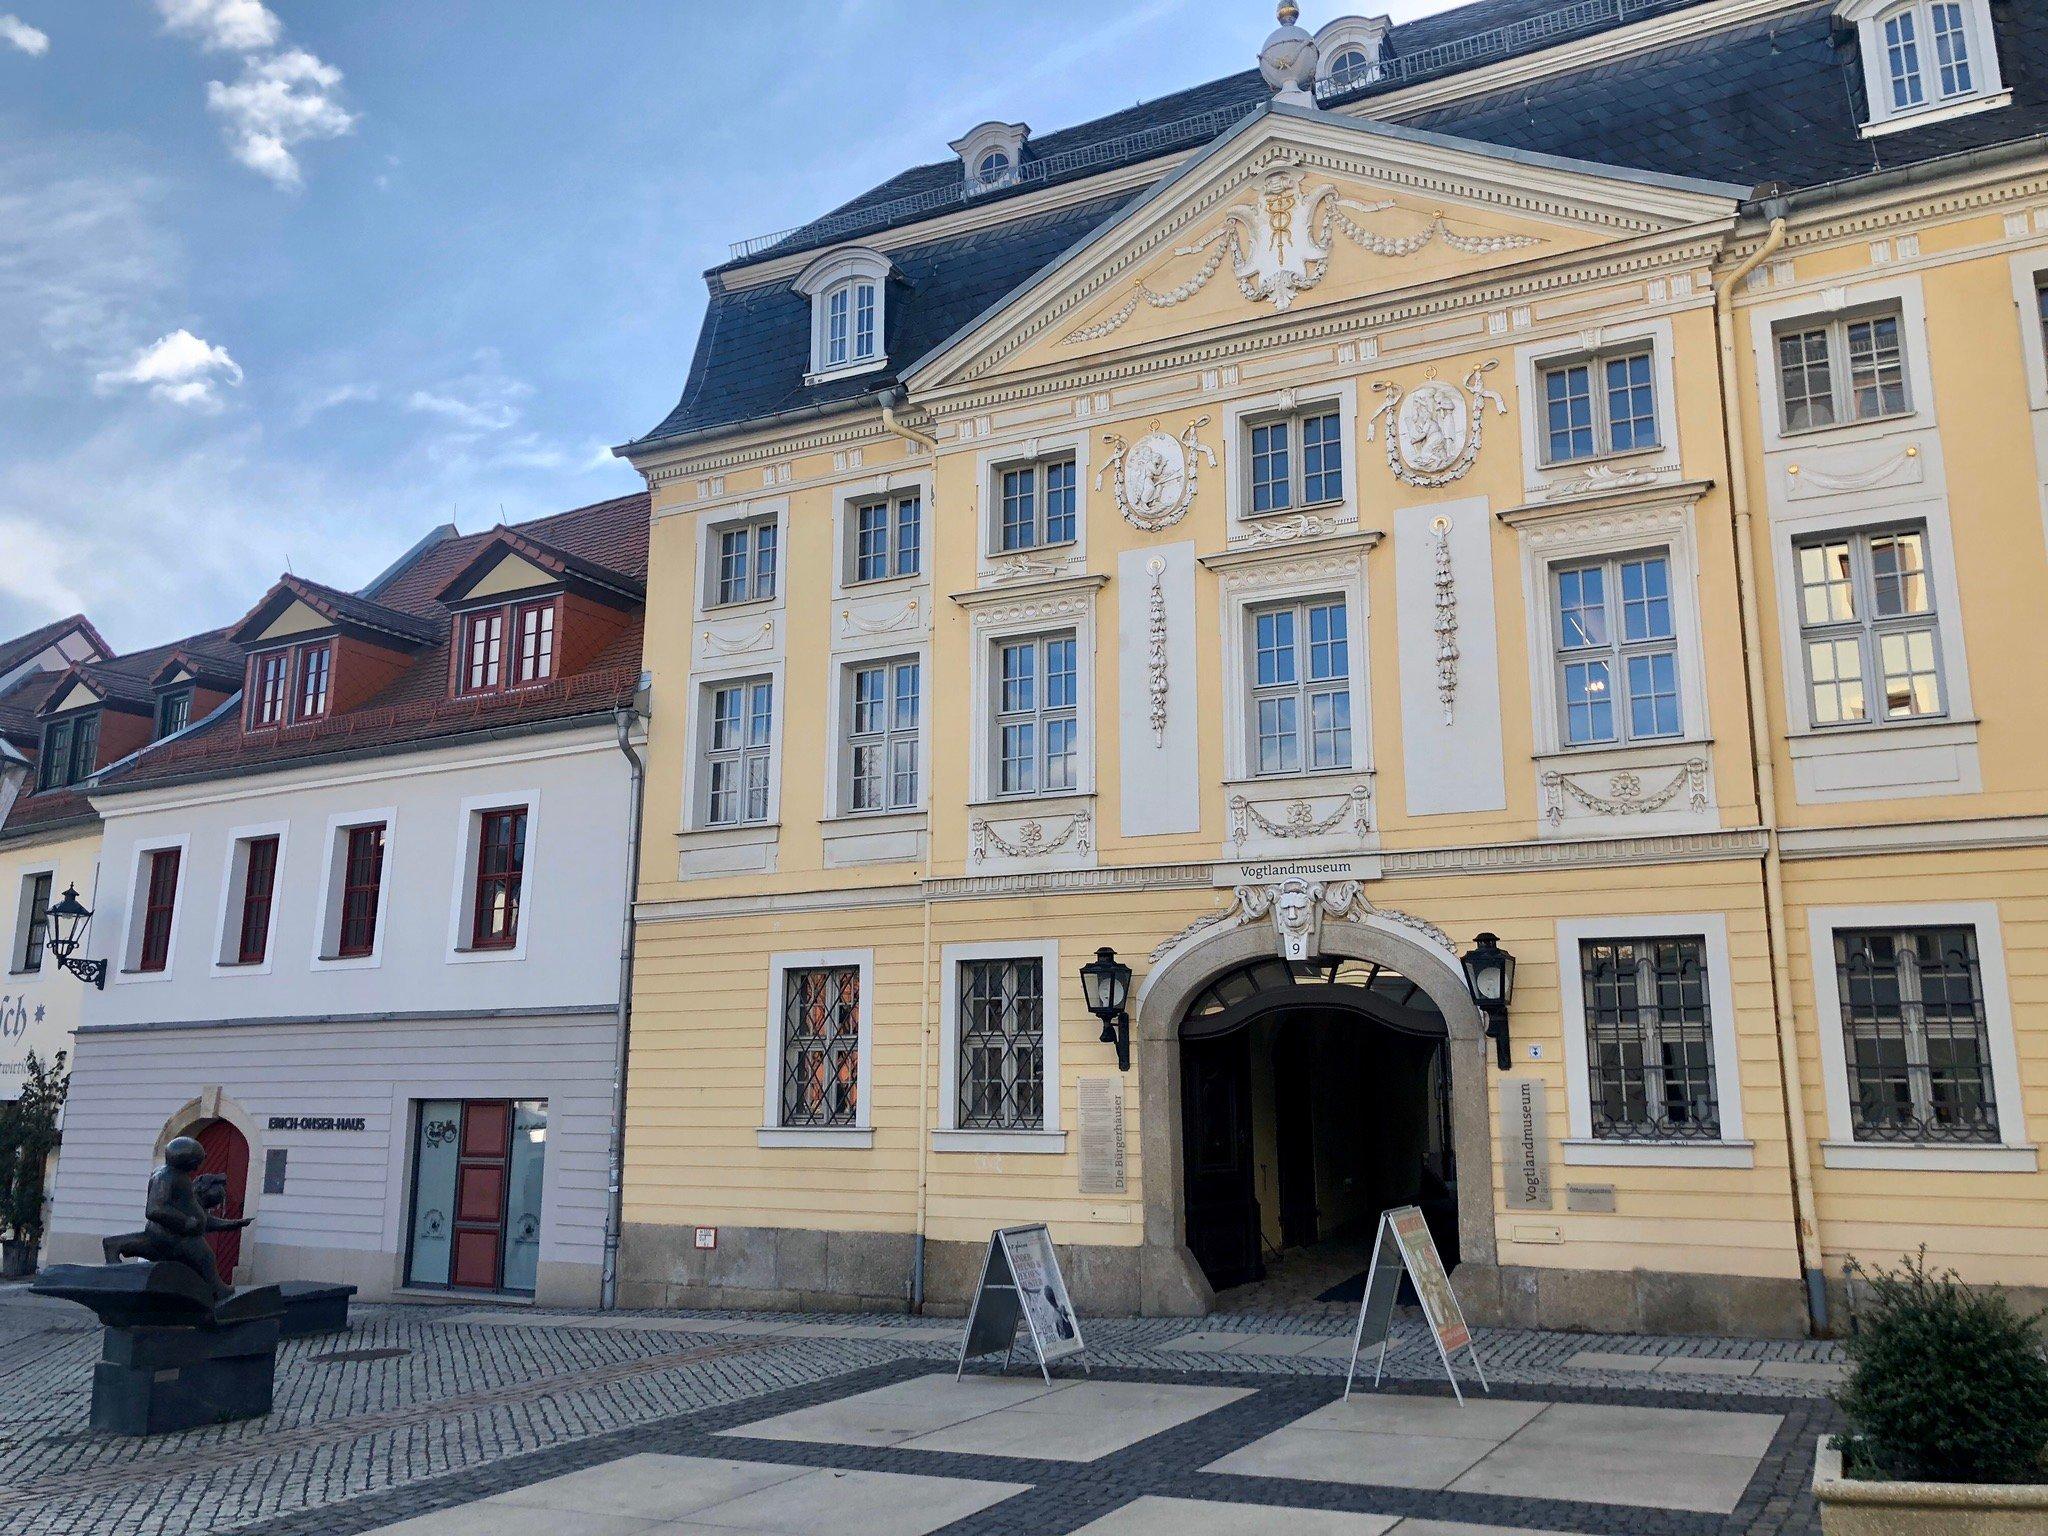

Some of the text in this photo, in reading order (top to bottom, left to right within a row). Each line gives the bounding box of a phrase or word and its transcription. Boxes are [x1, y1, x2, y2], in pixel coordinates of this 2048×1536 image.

[1241, 861, 1351, 879] Vogtlandmuseum
[268, 1117, 366, 1131] ERICH-OHSER-HAUS
[1113, 1094, 1125, 1188] Die Bürgerhäuser
[1520, 1083, 1540, 1202] Vogtlandmuseum
